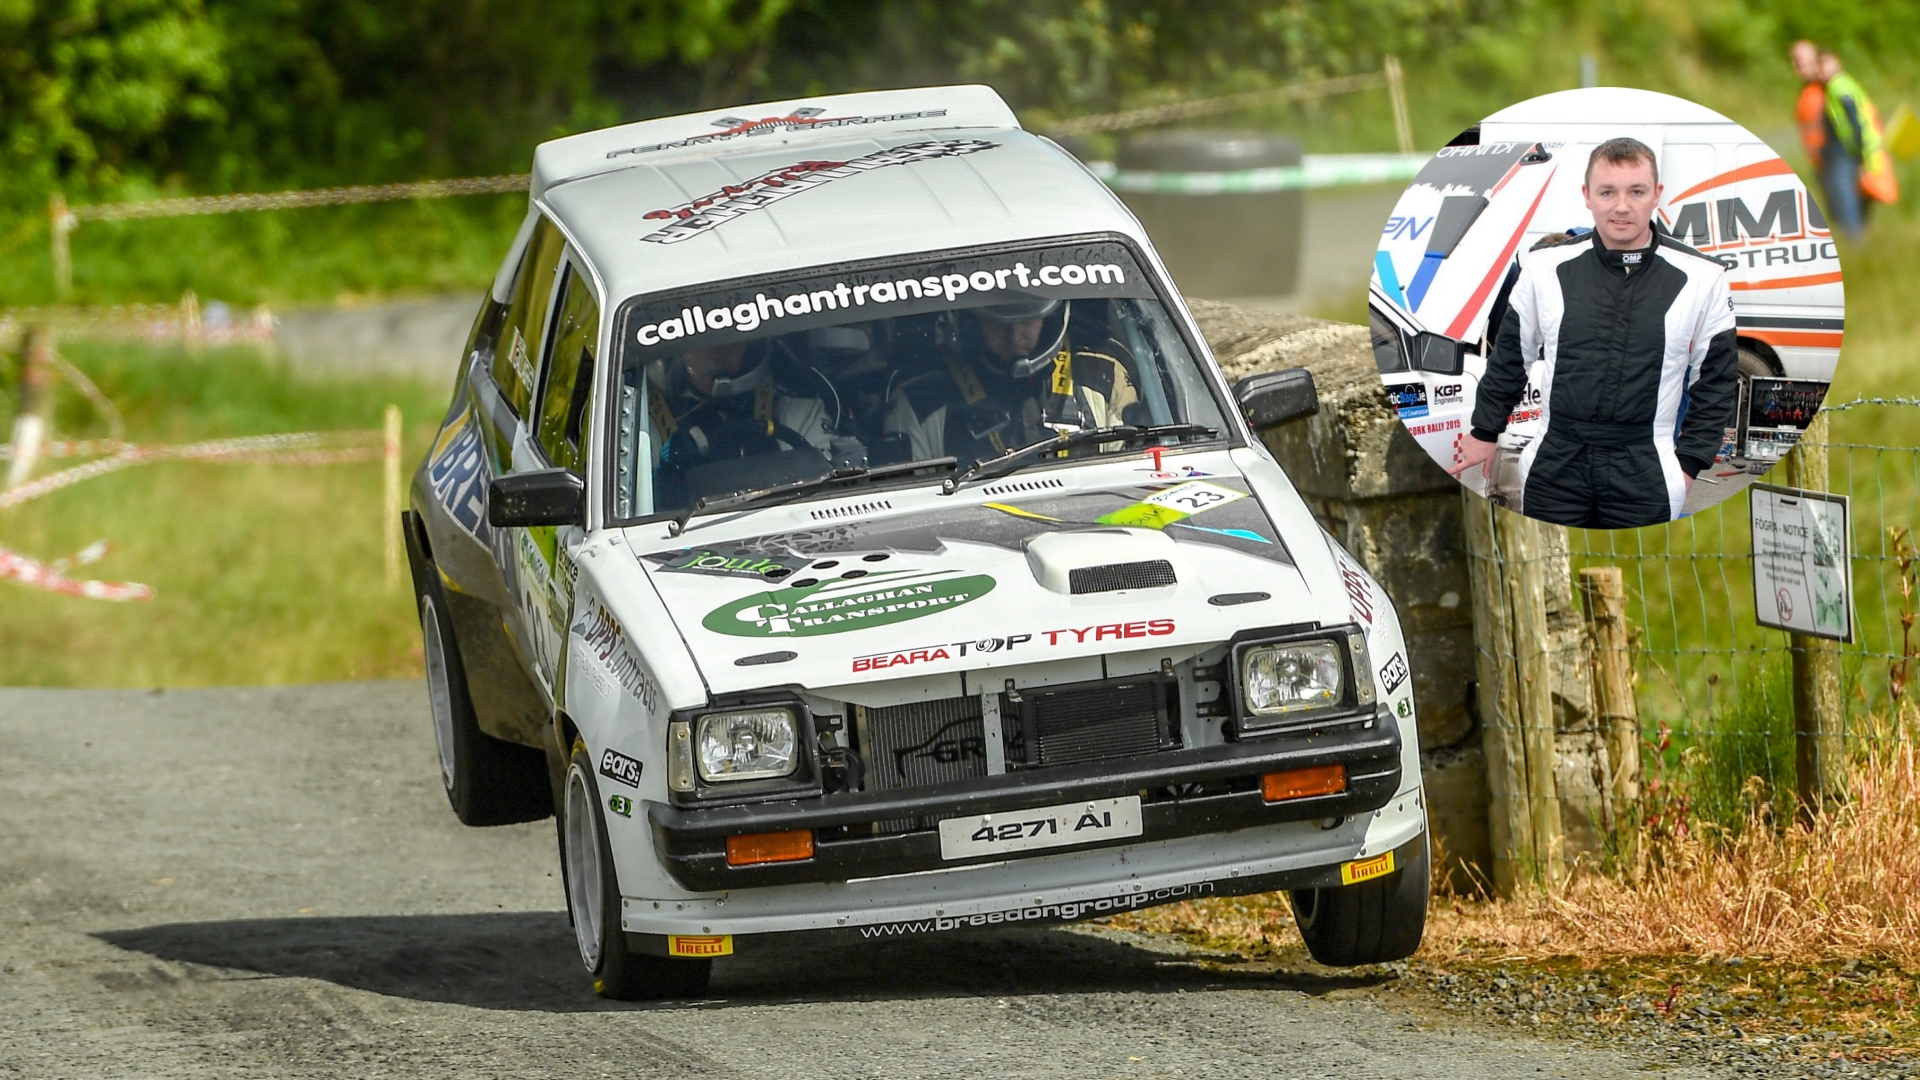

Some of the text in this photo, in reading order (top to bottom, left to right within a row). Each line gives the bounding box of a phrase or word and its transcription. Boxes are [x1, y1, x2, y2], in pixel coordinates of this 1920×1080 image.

[786, 109, 948, 131] GARAGE
[1436, 142, 1516, 158] KUMHO
[1622, 253, 1642, 263] OMP
[636, 261, 1126, 347] callaghantransport.com
[1434, 384, 1462, 398] KGP
[1434, 396, 1463, 405] Engineering
[1408, 419, 1461, 437] CORK RALLY 2015
[1176, 491, 1226, 508] 23
[1783, 523, 1808, 538] NOTICE
[735, 585, 954, 624] CALLAGHAN
[757, 593, 969, 634] TRANSPORT
[852, 648, 950, 673] BEARA
[1041, 619, 1175, 646] TYRES
[606, 637, 657, 717] Contracts
[971, 811, 1111, 842] 4271 AI
[1351, 854, 1388, 879] PIRELLI
[860, 881, 1214, 939] www.breedongroup.com
[676, 936, 723, 954] PIRELLI
